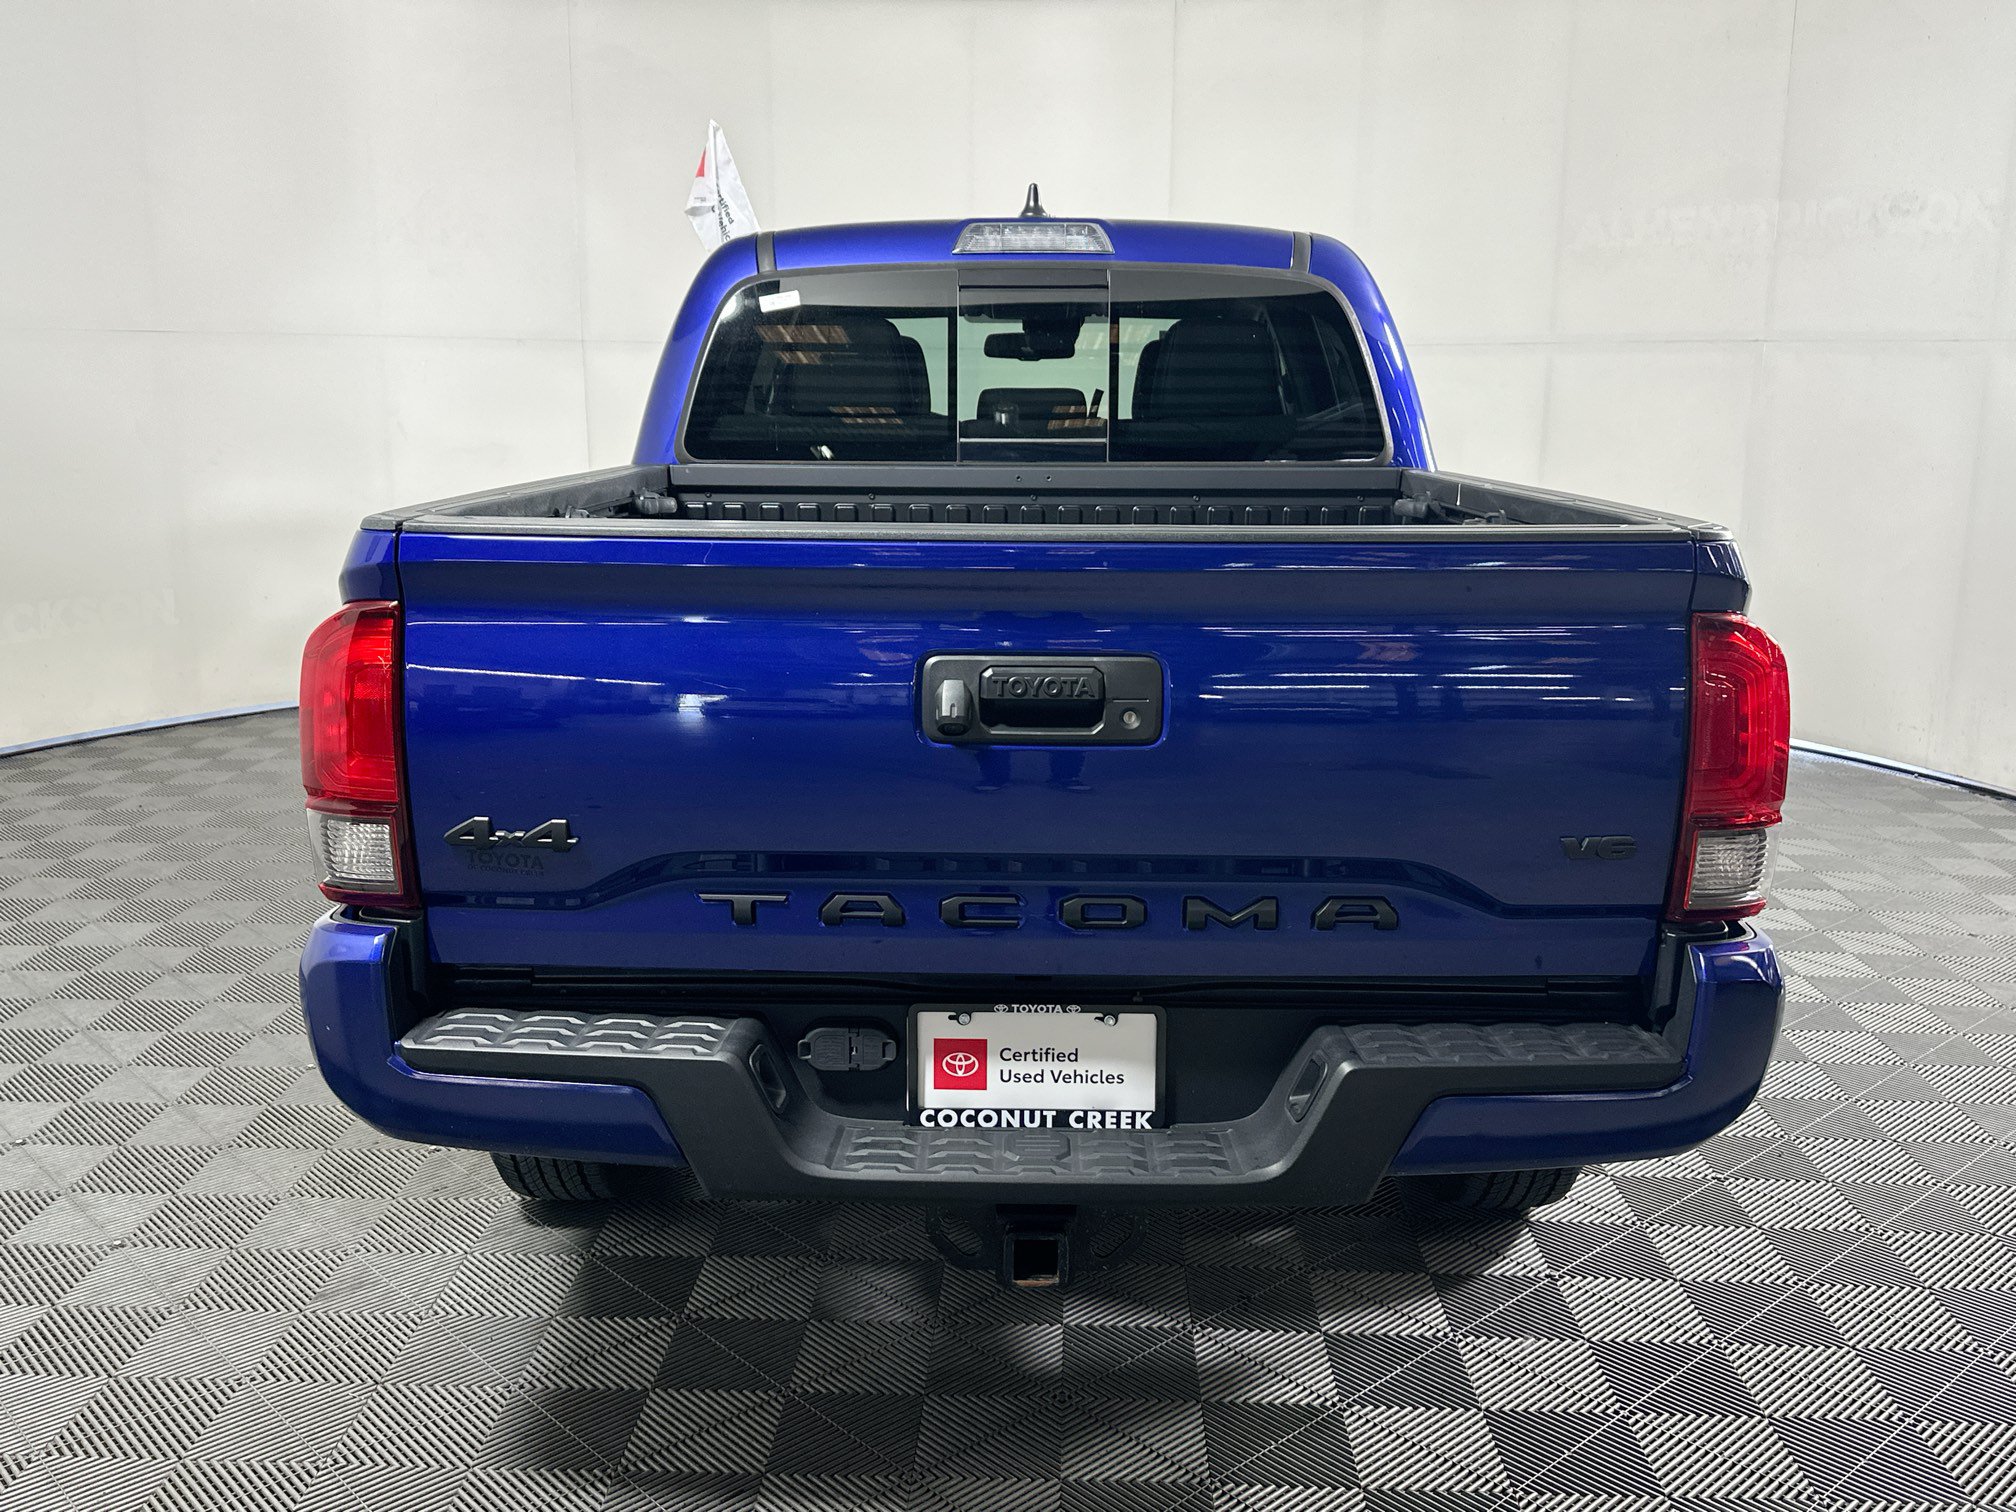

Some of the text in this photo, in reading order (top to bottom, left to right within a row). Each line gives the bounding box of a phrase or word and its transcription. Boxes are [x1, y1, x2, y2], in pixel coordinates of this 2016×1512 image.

[992, 676, 1096, 698] TOYOTA
[1560, 835, 1637, 860] V6
[466, 849, 544, 870] TOYOTA
[697, 892, 1399, 931] TACOMA
[1011, 1004, 1063, 1013] TOYOTA
[999, 1047, 1079, 1063] Certified
[999, 1069, 1125, 1085] Used Vehicles
[919, 1109, 1152, 1129] COCONUT CREEK
